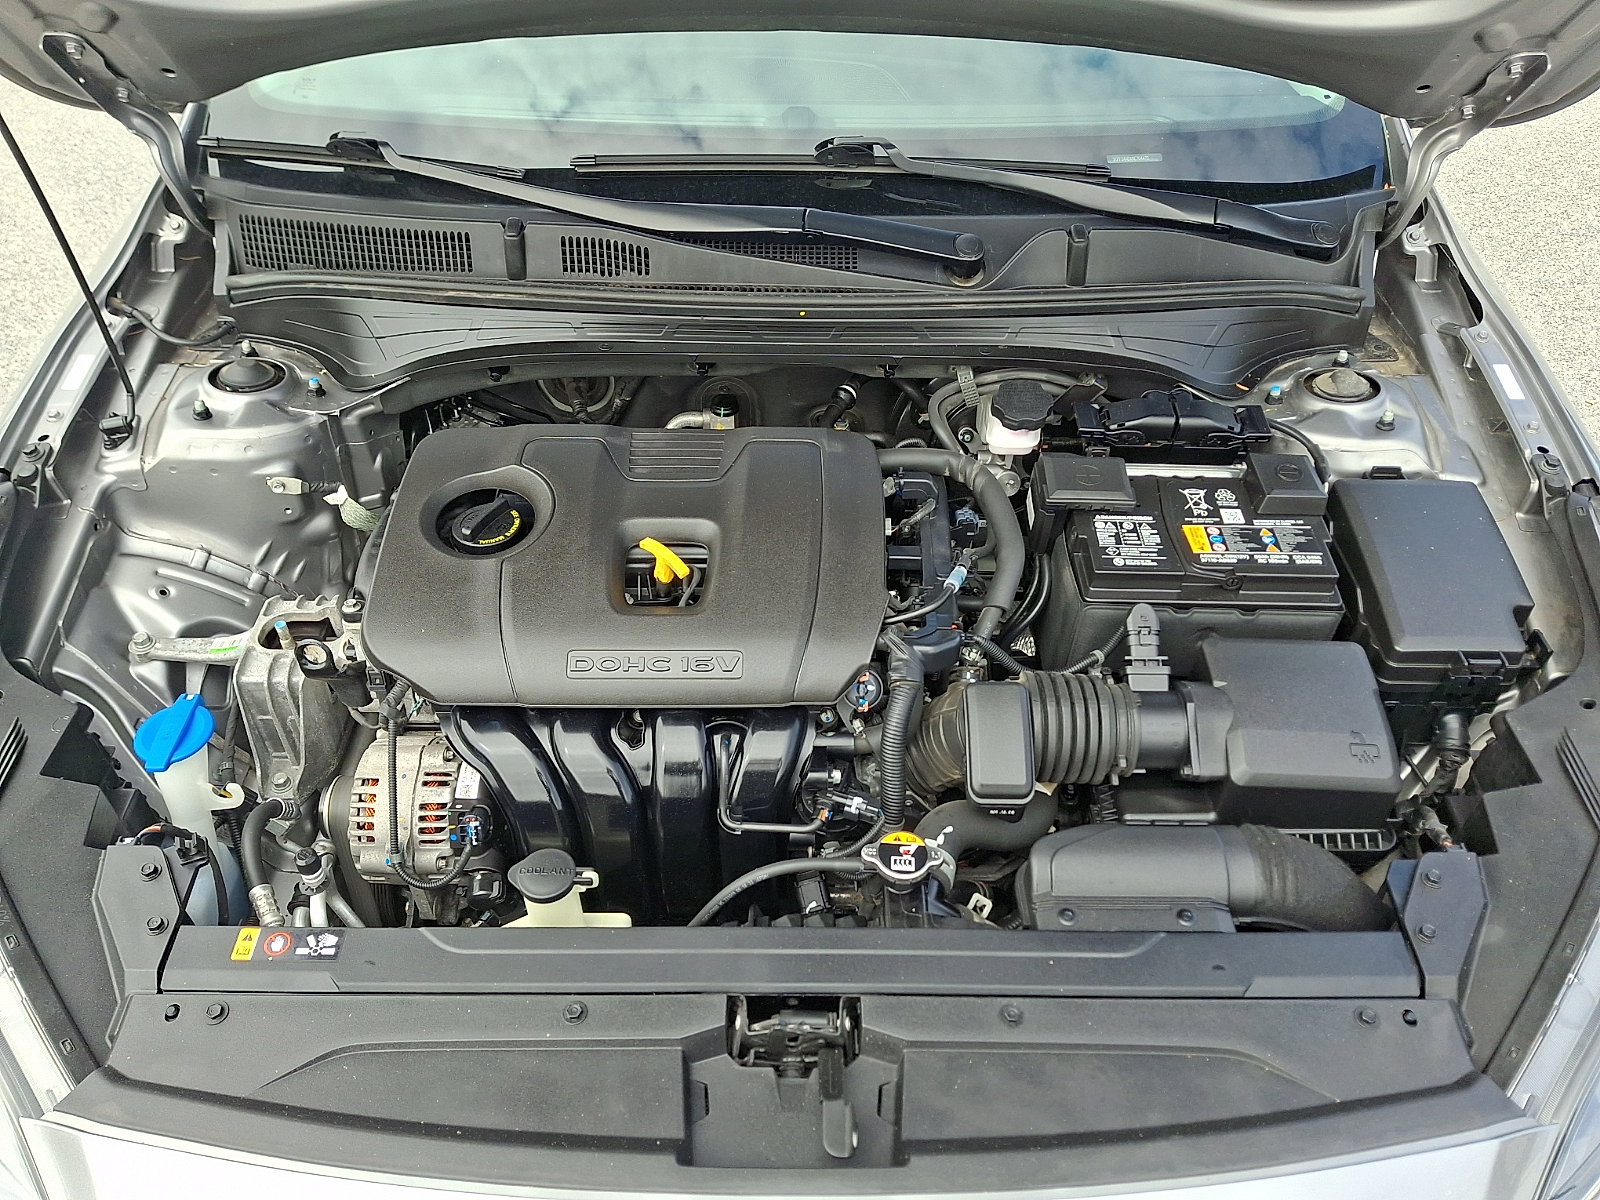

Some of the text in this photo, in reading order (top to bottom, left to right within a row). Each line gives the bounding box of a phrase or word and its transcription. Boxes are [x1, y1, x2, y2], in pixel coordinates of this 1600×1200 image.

[1194, 509, 1208, 517] Pb
[478, 536, 505, 544] MANUAL
[570, 656, 741, 672] DOHC 16V
[519, 866, 573, 876] COOLANT
